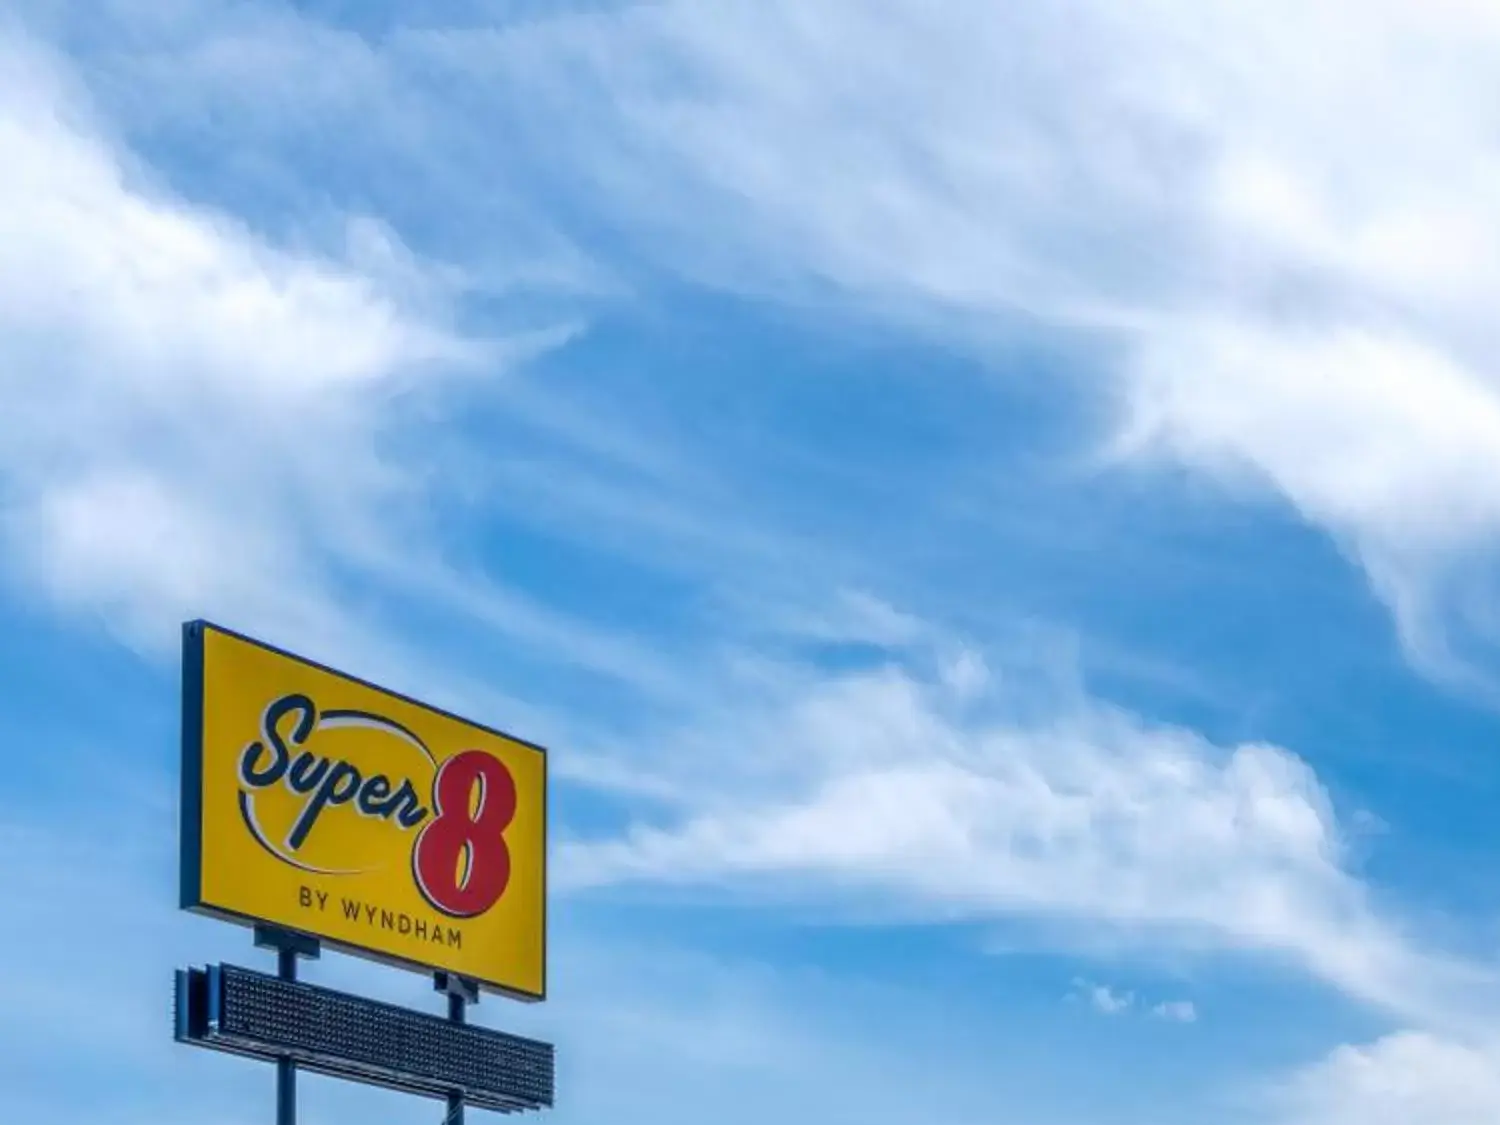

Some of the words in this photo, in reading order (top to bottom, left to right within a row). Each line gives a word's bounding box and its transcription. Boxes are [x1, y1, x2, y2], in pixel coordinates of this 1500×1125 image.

[240, 693, 428, 850] Super
[412, 750, 517, 919] 8
[299, 886, 328, 911] BY
[341, 898, 462, 950] WYNDHAM
